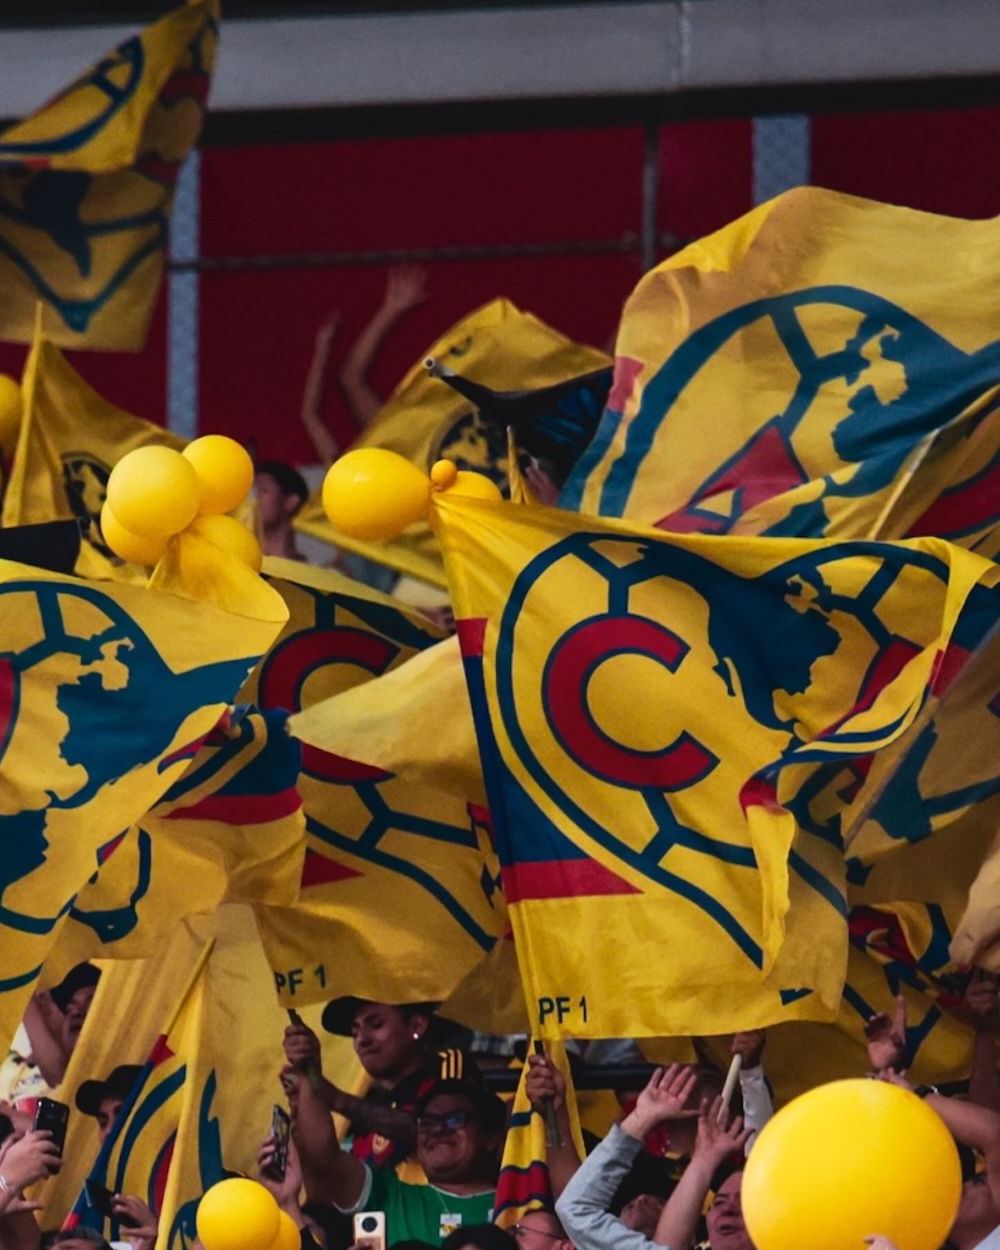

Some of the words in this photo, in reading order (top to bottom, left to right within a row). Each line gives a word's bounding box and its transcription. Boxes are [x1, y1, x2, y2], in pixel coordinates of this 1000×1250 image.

[541, 613, 720, 793] C
[274, 968, 303, 996] PF
[314, 964, 326, 988] 1
[538, 996, 570, 1025] PF
[579, 994, 587, 1024] 1
